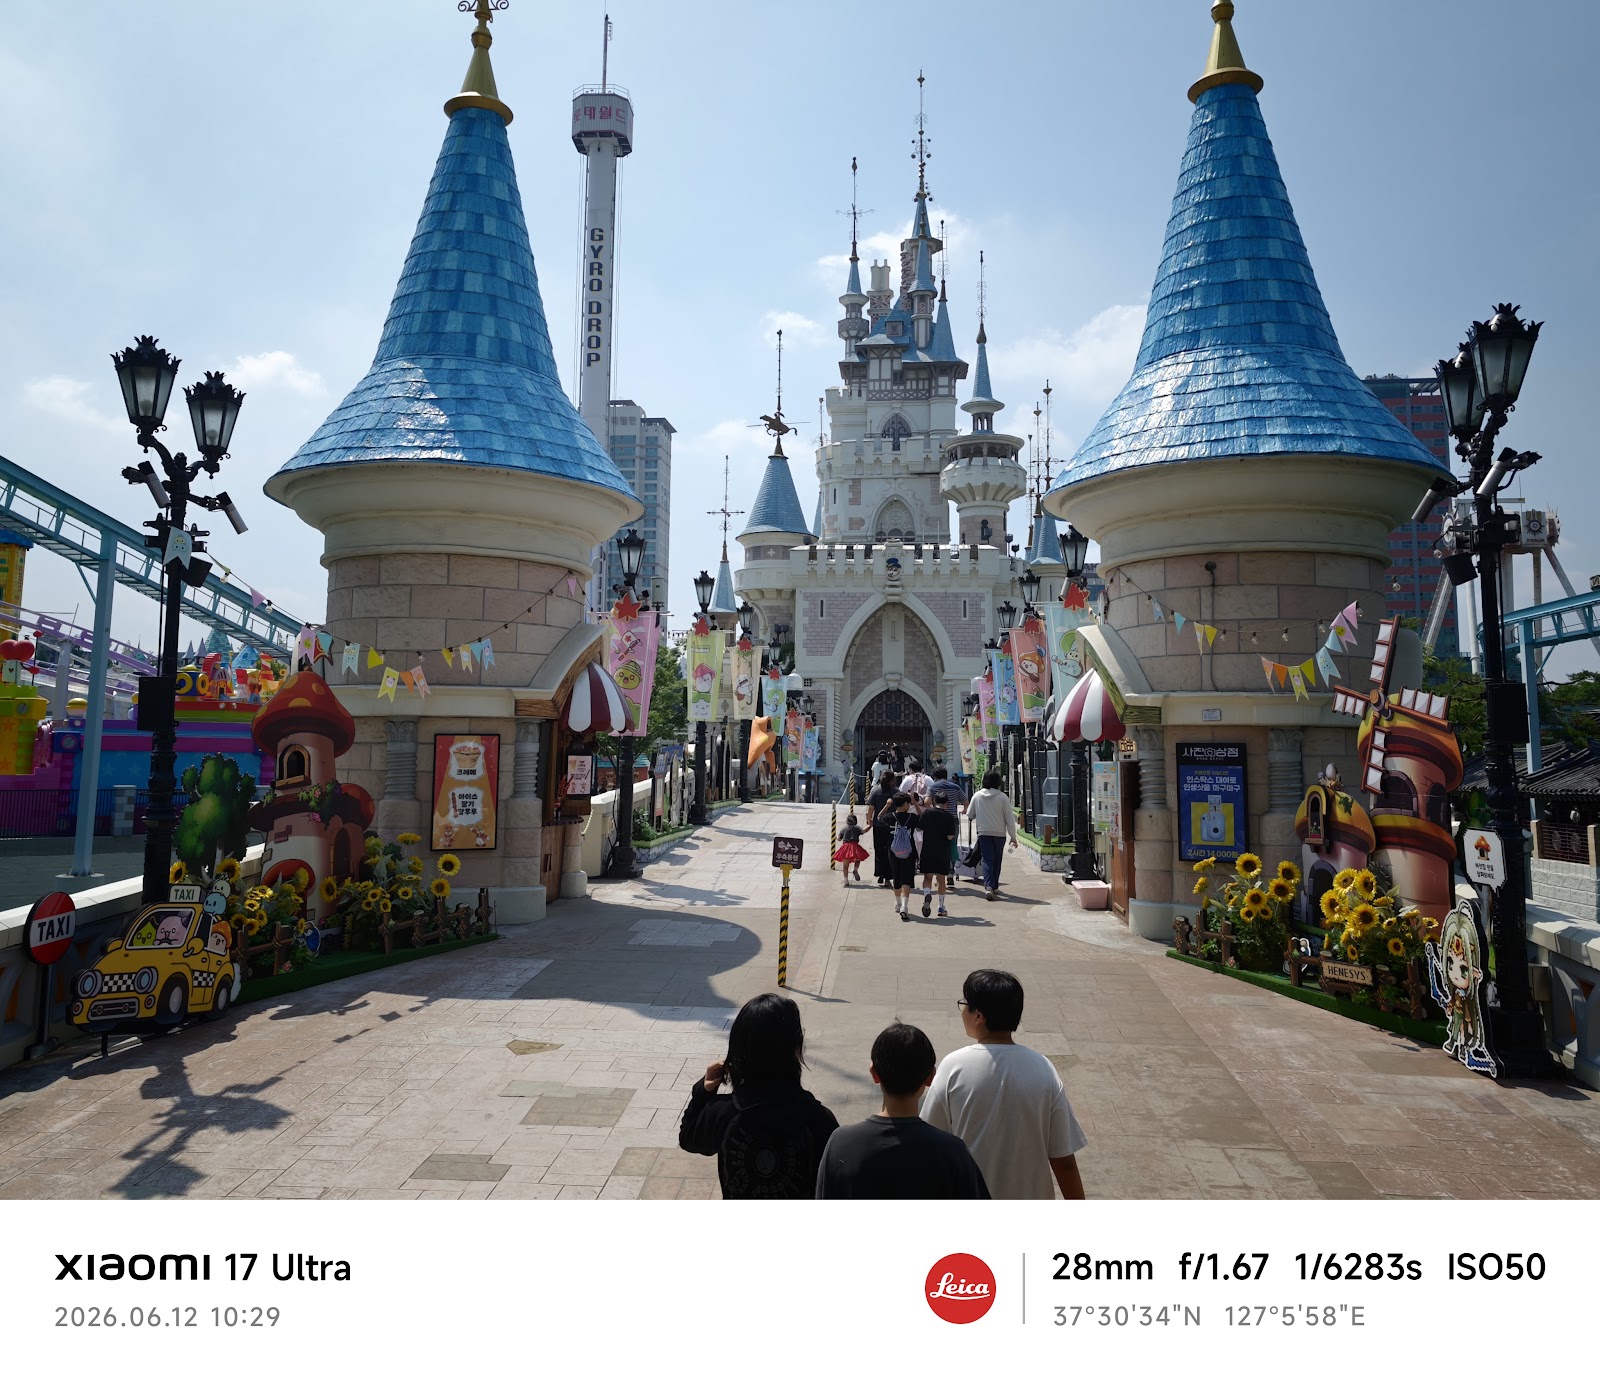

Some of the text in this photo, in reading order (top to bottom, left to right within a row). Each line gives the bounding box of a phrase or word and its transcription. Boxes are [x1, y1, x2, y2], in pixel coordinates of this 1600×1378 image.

[586, 228, 604, 367] GYRO DROP
[1186, 776, 1237, 784] 인스탁스 대여로
[1212, 784, 1241, 792] 마구마구
[1187, 849, 1206, 857] 2시간
[174, 889, 195, 900] TAXI
[37, 915, 70, 942] TAXI
[1327, 965, 1366, 981] HENESYS
